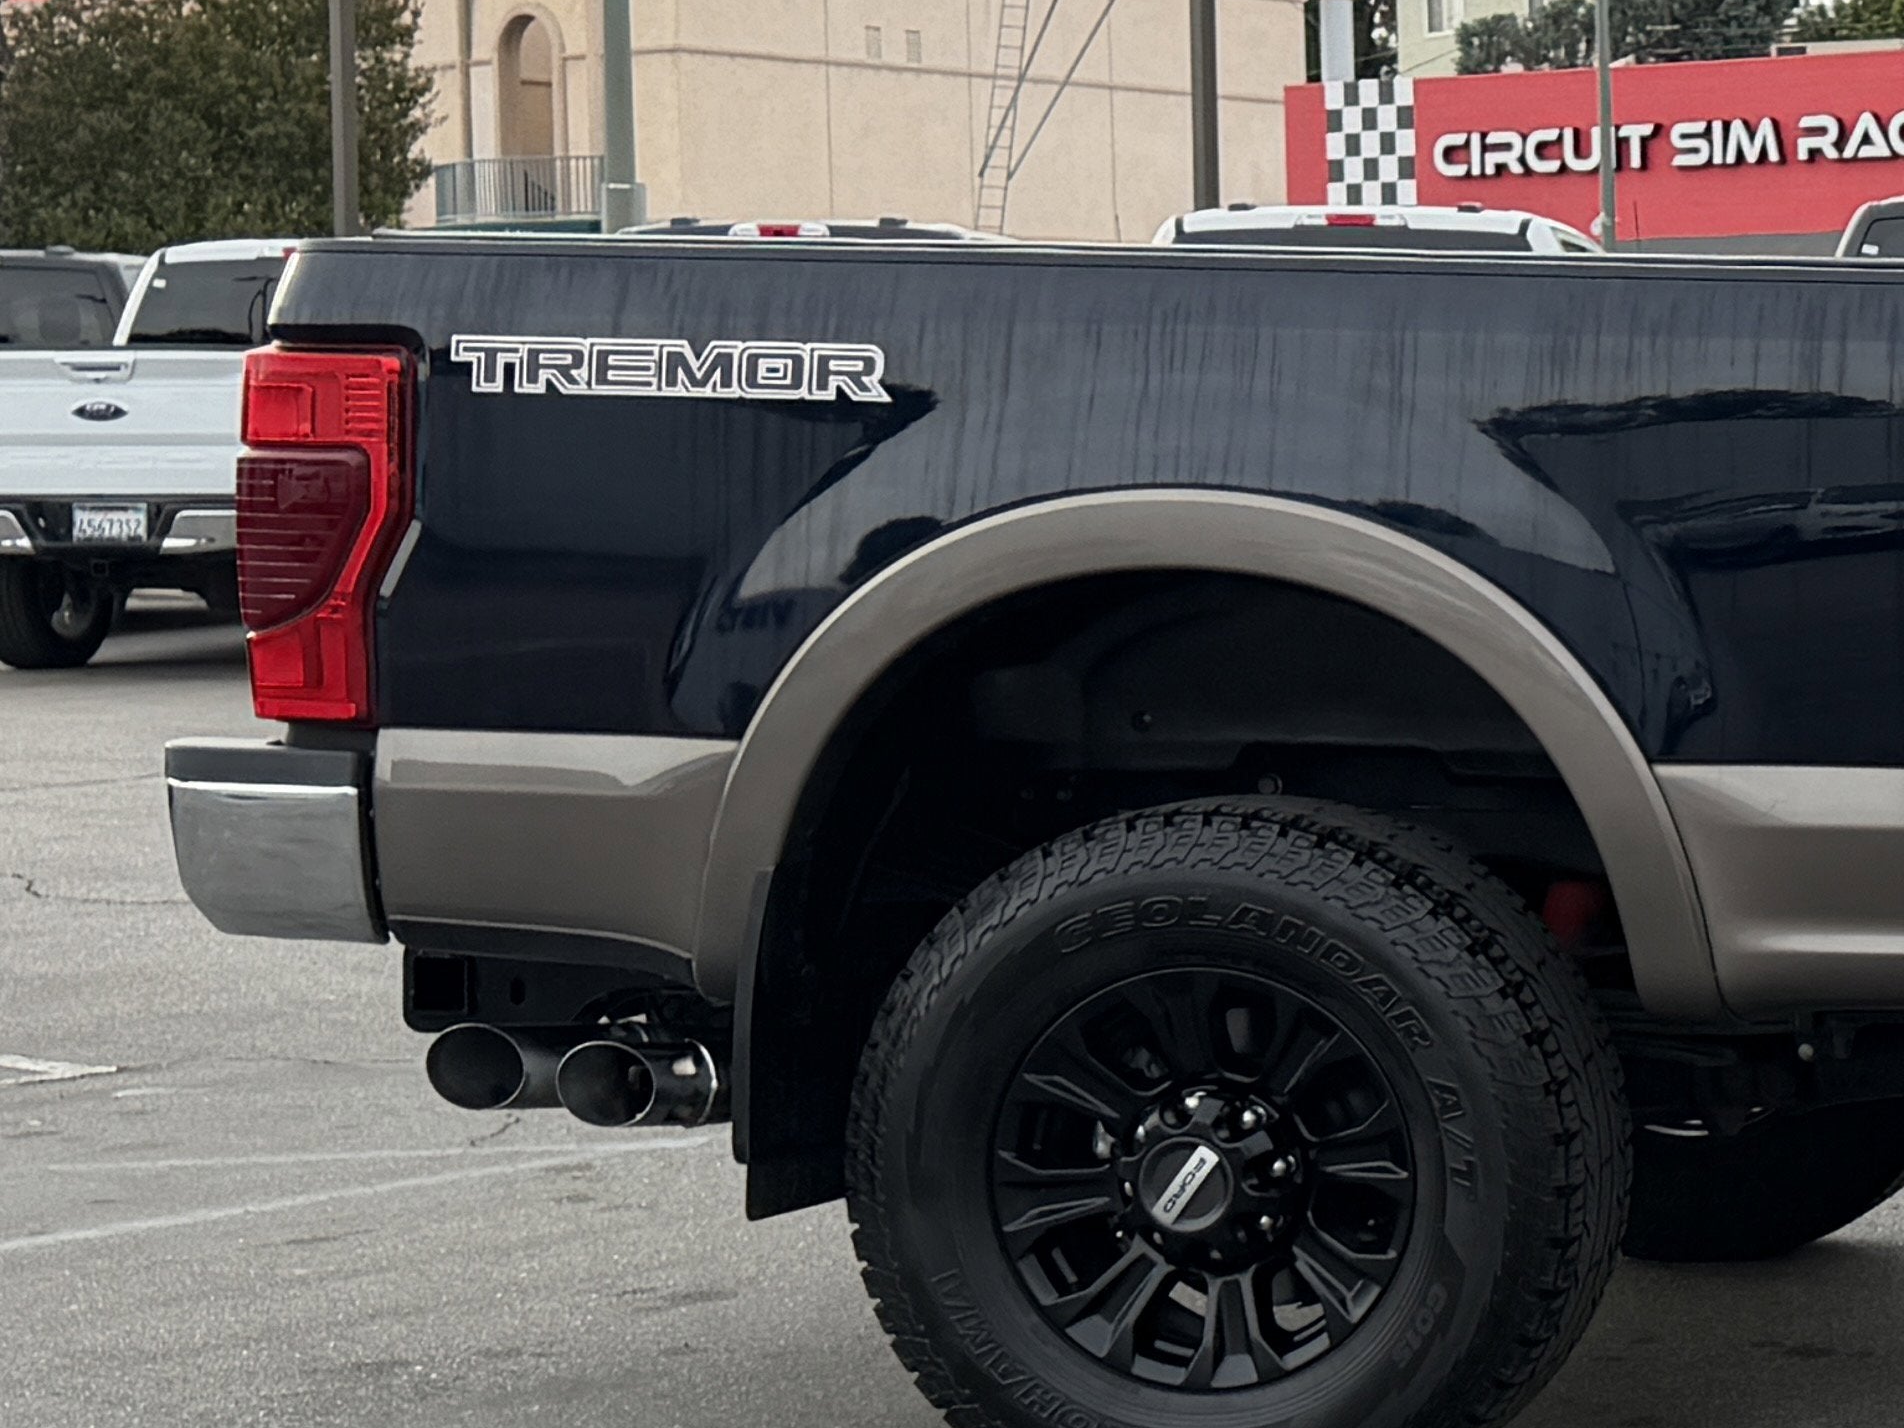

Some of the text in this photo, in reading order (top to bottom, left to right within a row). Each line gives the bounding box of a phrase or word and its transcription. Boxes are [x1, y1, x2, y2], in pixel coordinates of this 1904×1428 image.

[1433, 122, 1656, 177] CIRCUIT
[1669, 117, 1780, 167] SIM
[450, 334, 893, 403] TREMOR
[1053, 895, 1435, 1048] GEOLANDAR
[1163, 1156, 1209, 1214] FORD
